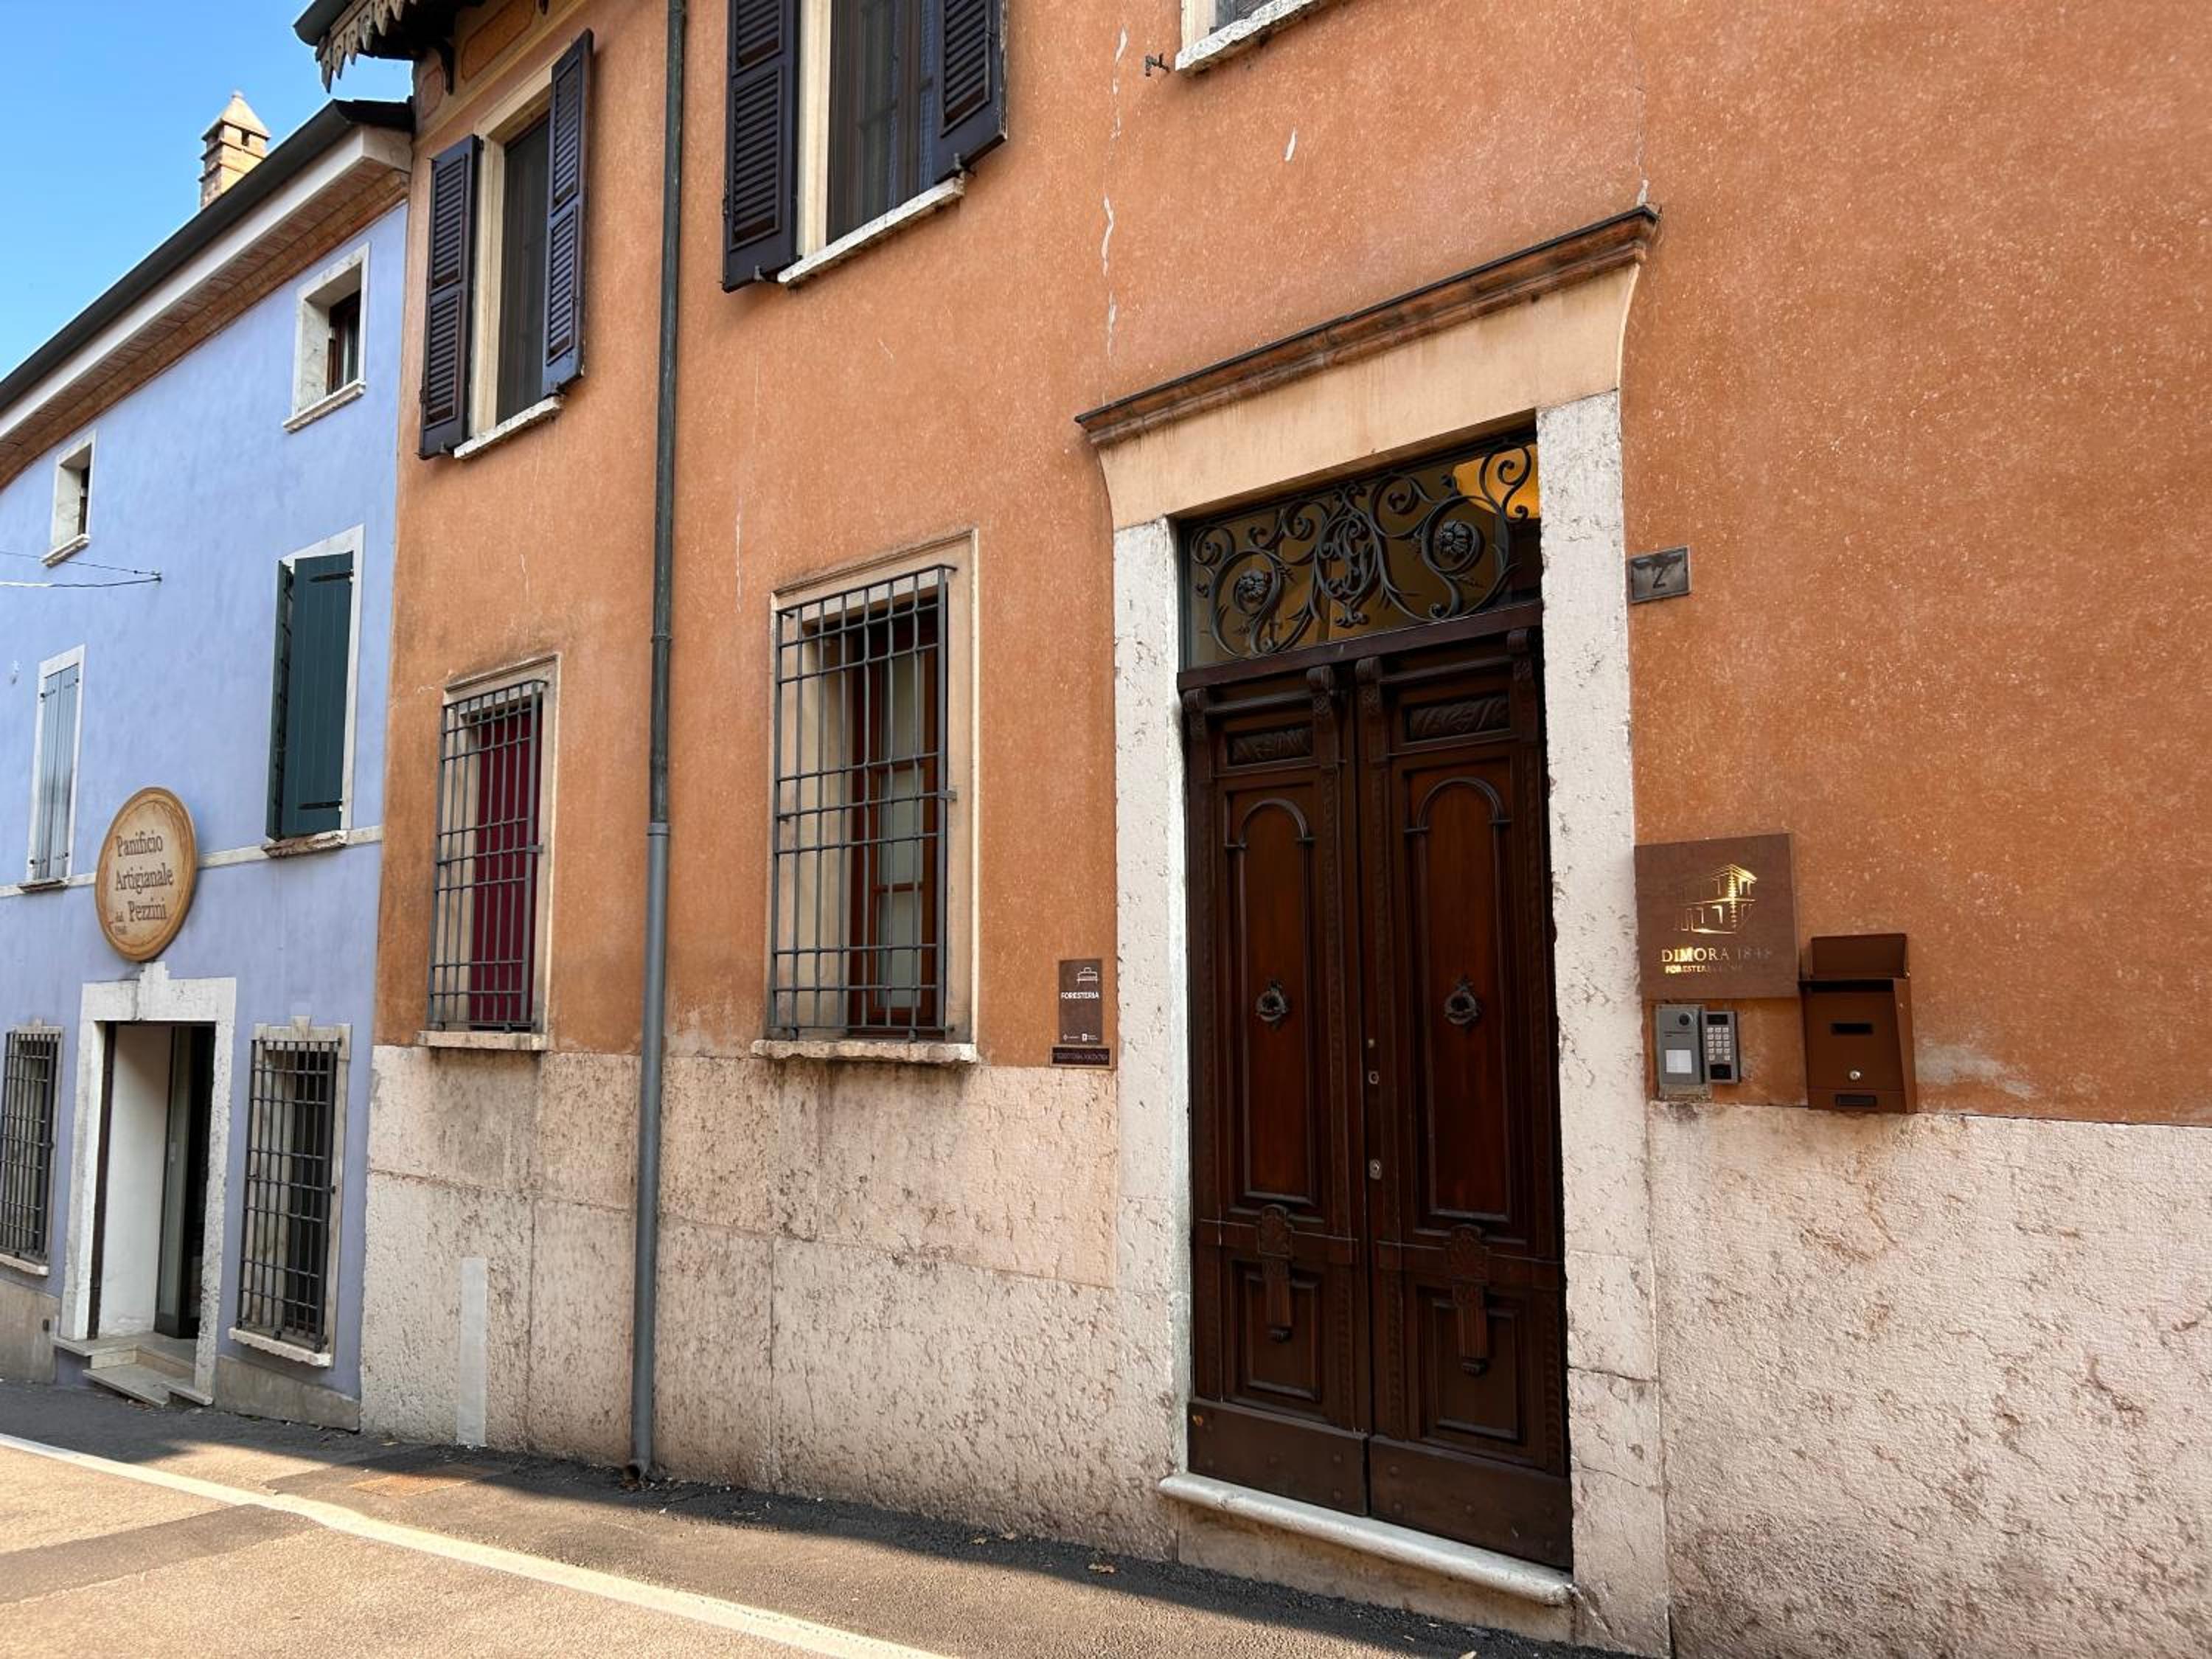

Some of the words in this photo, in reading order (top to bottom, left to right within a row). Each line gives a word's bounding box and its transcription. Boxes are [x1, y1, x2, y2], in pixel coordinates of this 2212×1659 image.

[116, 830, 163, 857] Panificio
[115, 862, 174, 894] Artigianale
[128, 897, 167, 922] Pezzini
[1660, 947, 1729, 962] DIMORA
[1060, 992, 1099, 1000] FORESTERIA
